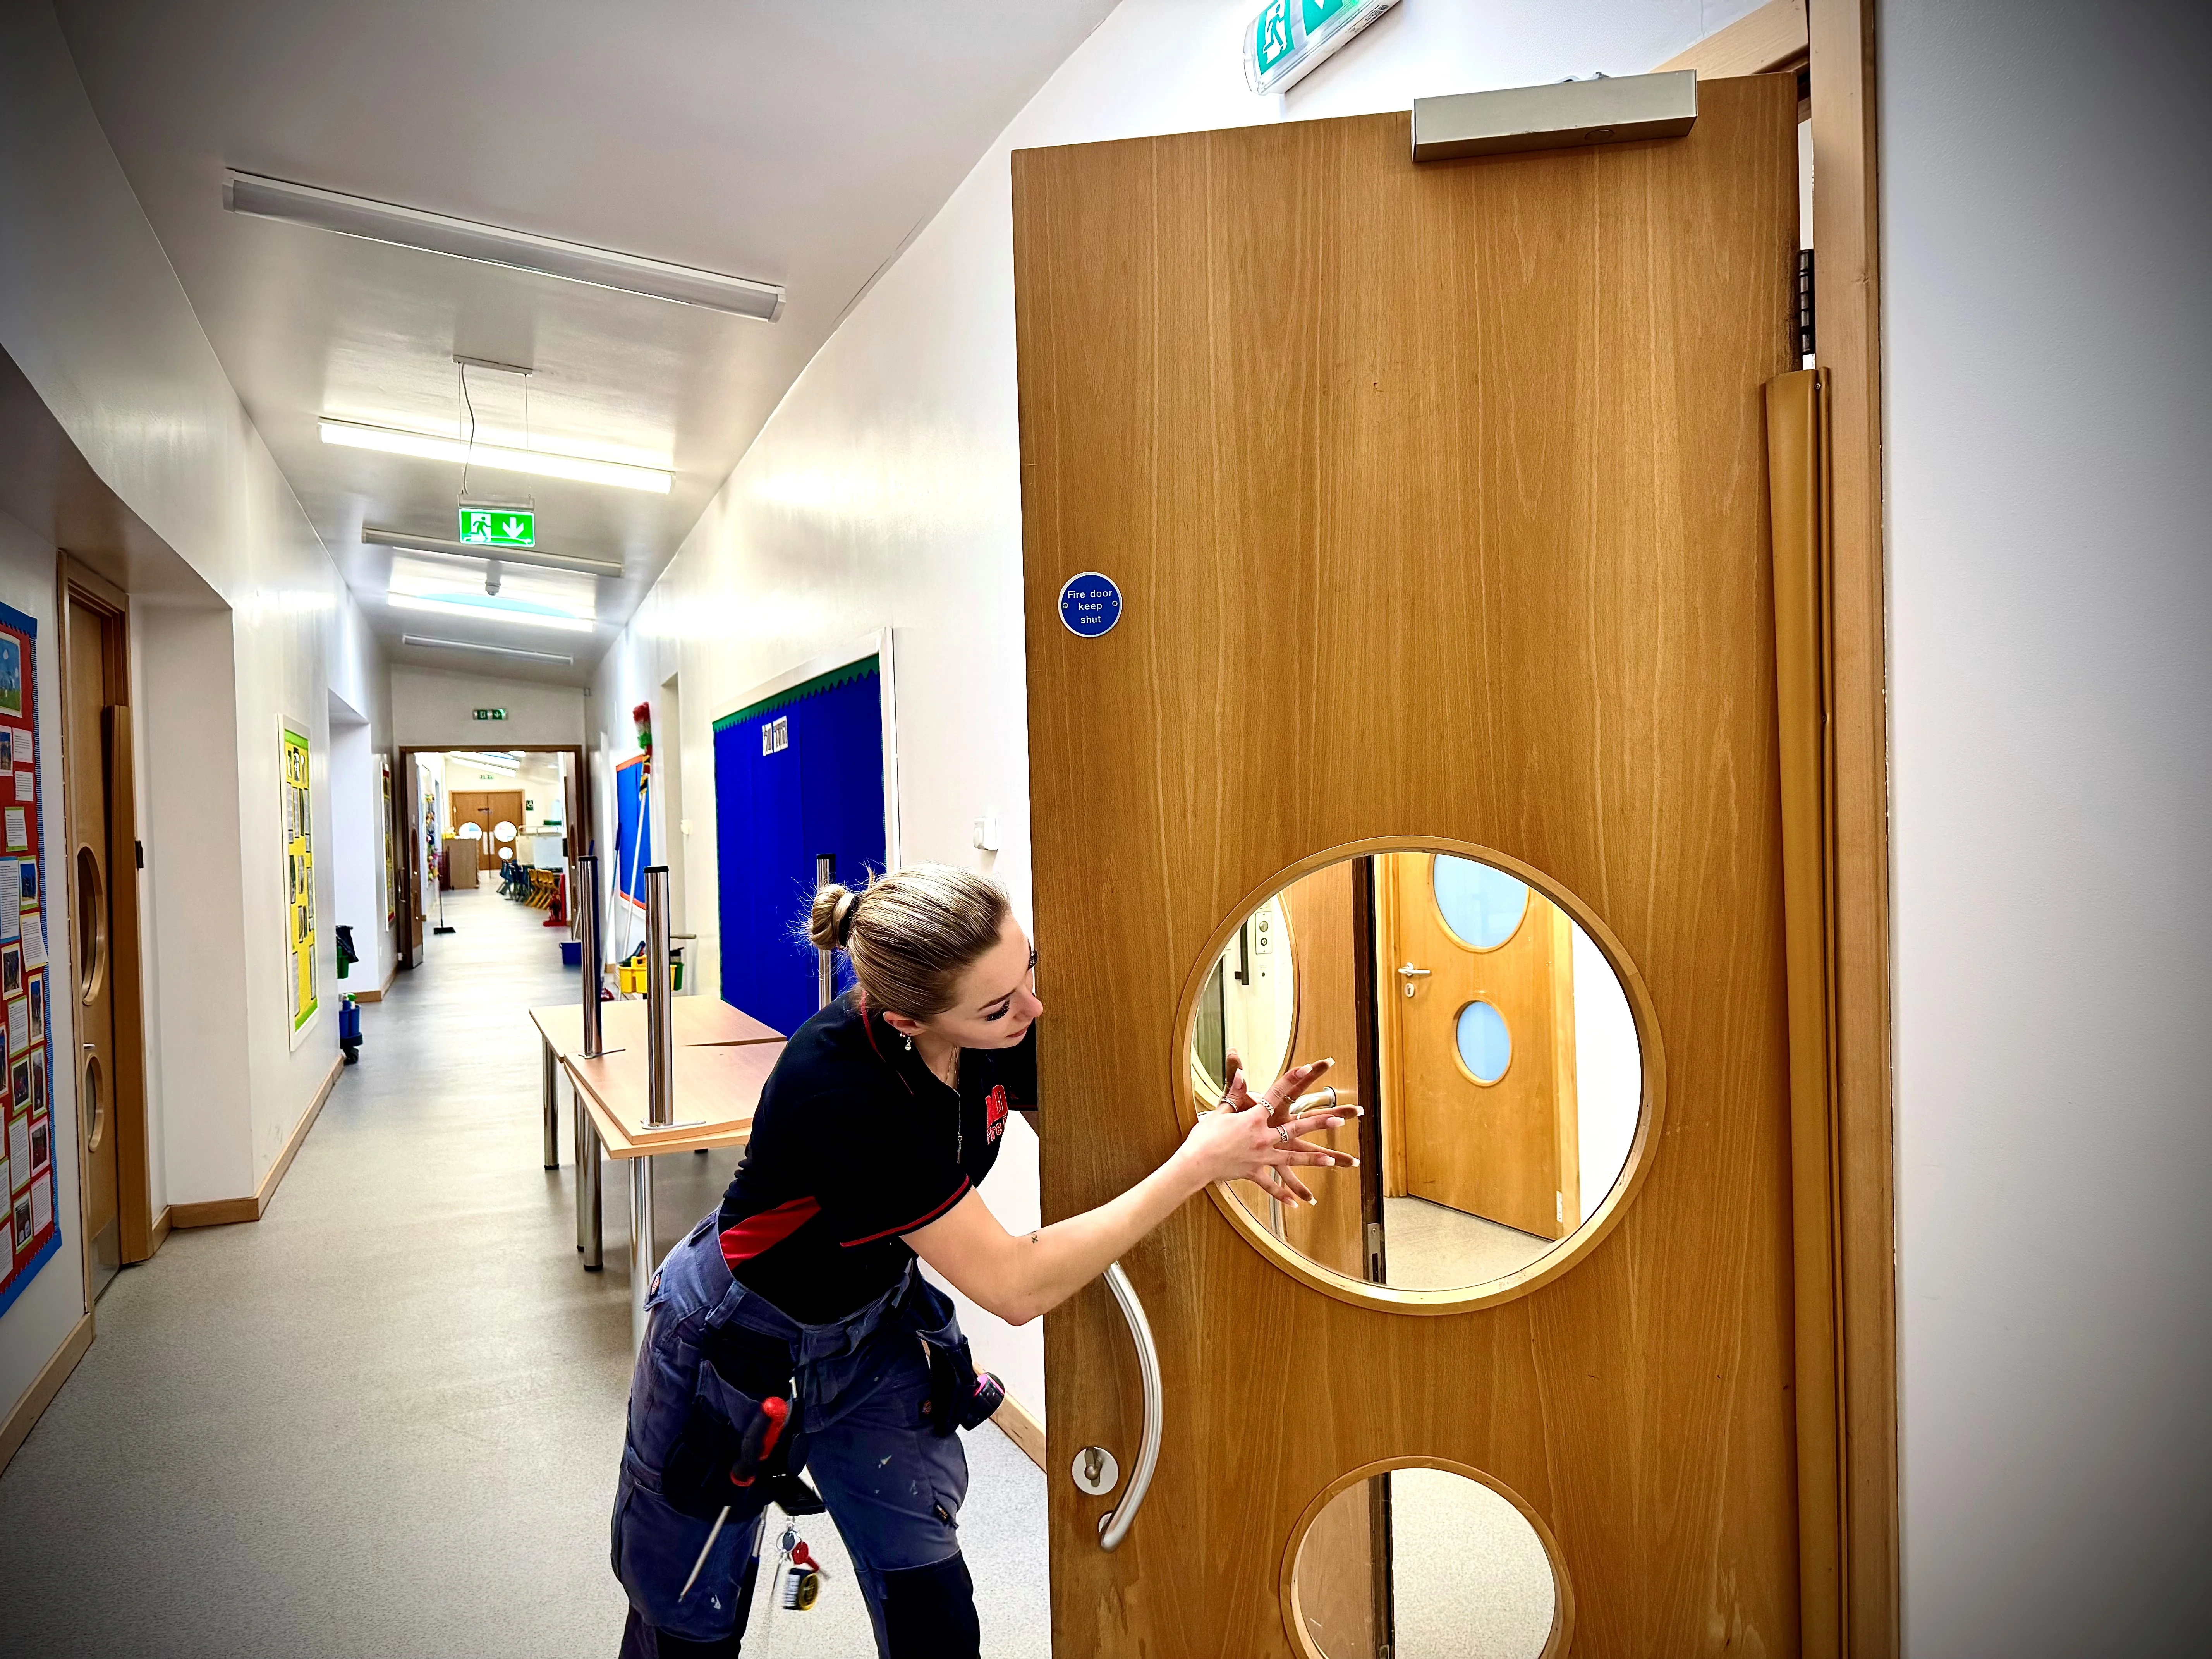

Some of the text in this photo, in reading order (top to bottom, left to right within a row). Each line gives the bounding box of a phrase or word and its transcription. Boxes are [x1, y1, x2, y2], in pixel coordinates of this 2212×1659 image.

[1068, 591, 1085, 599] Fire
[1079, 602, 1102, 611] keep
[1080, 615, 1101, 623] shut
